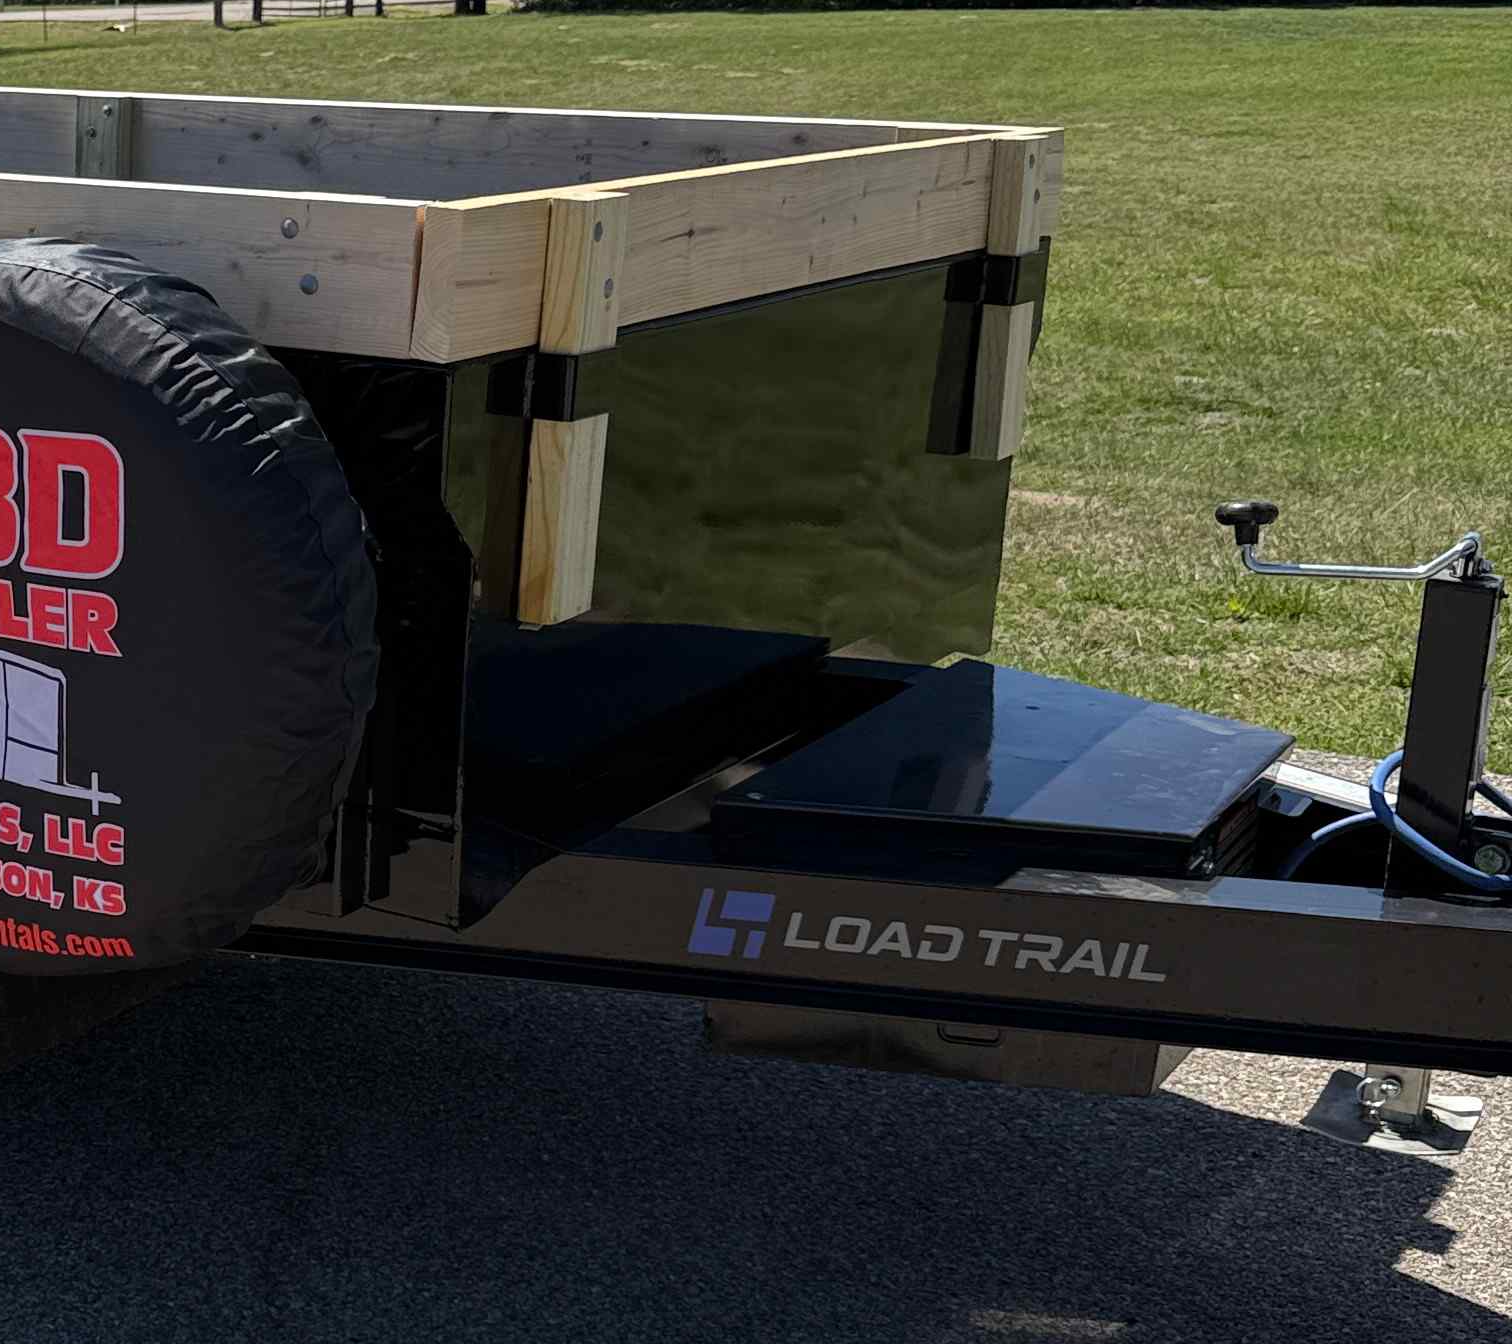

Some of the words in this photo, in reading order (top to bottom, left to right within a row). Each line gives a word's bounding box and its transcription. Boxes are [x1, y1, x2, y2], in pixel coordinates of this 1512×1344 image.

[44, 813, 125, 865] LLC
[72, 876, 126, 915] KS
[784, 912, 963, 961] LOAD
[979, 930, 1166, 982] TRAIL
